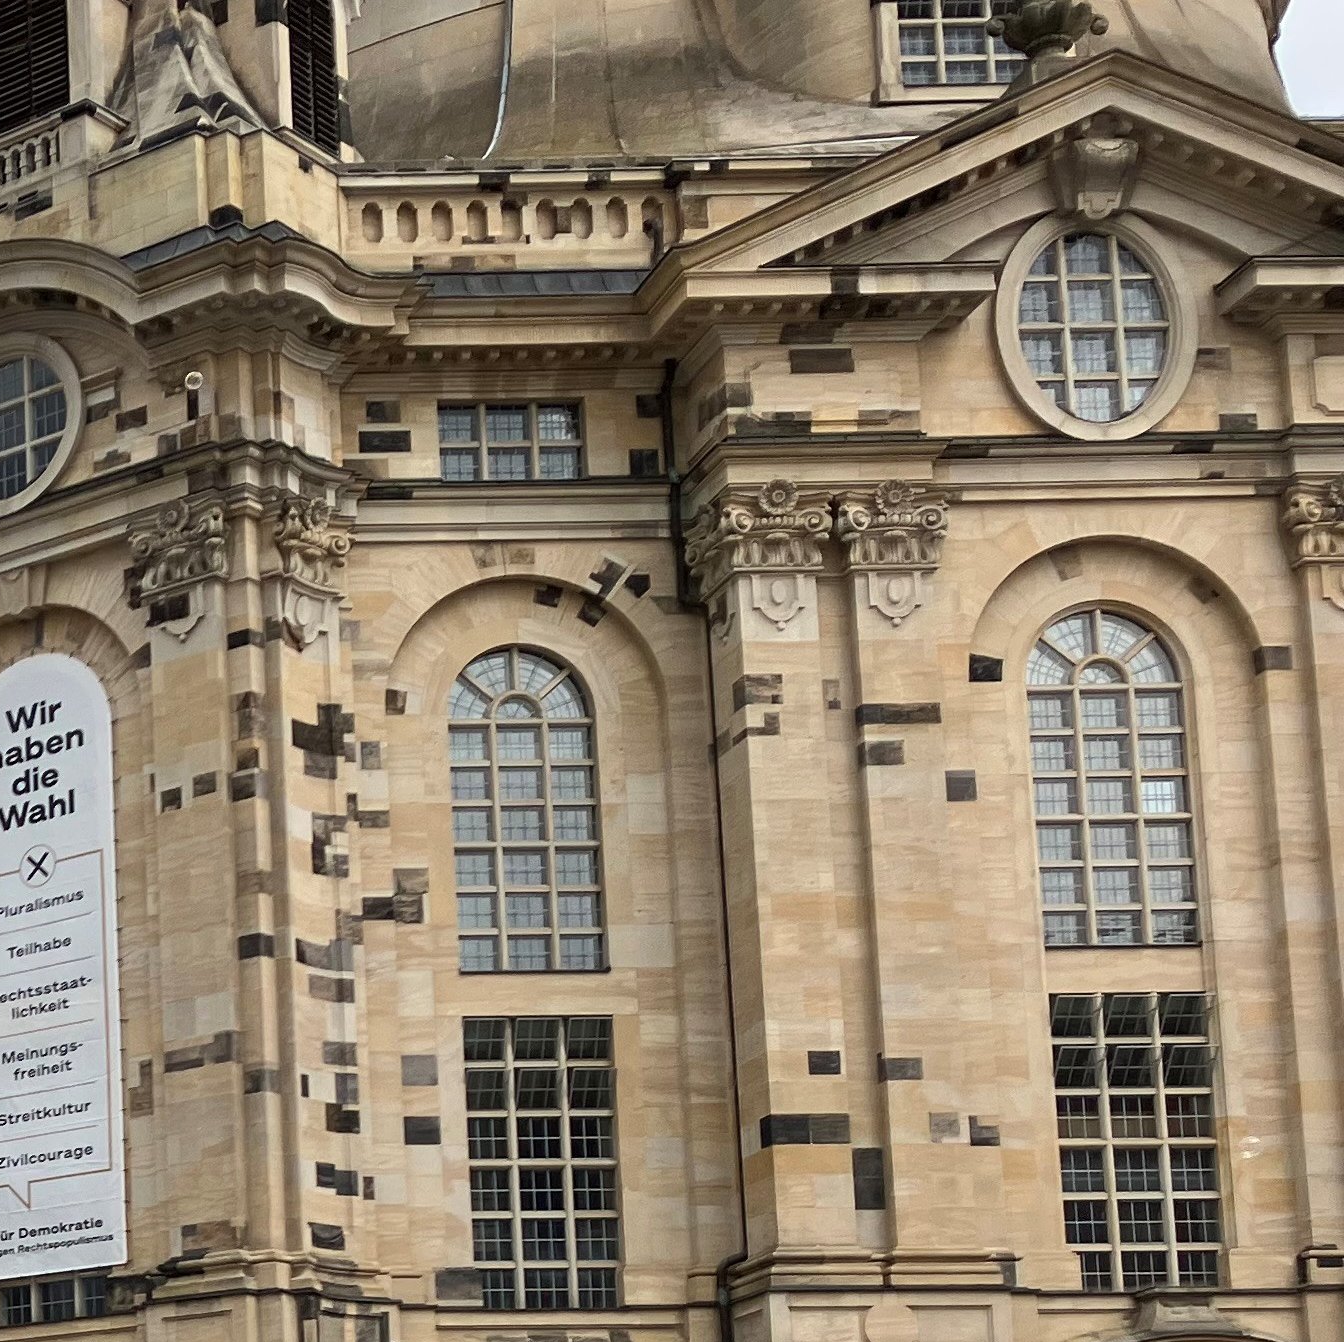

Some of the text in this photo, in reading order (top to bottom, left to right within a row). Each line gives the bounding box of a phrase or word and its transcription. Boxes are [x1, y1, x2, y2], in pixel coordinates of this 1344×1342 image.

[6, 700, 62, 733] Wir
[12, 767, 59, 796] die
[6, 936, 72, 959] Teilhabe
[12, 998, 70, 1020] lichkeit
[2, 1041, 83, 1065] Meinungs-
[13, 1060, 72, 1081] freiheit
[18, 1217, 103, 1239] Demokratie
[17, 1233, 114, 1254] Rechtspopulismus
